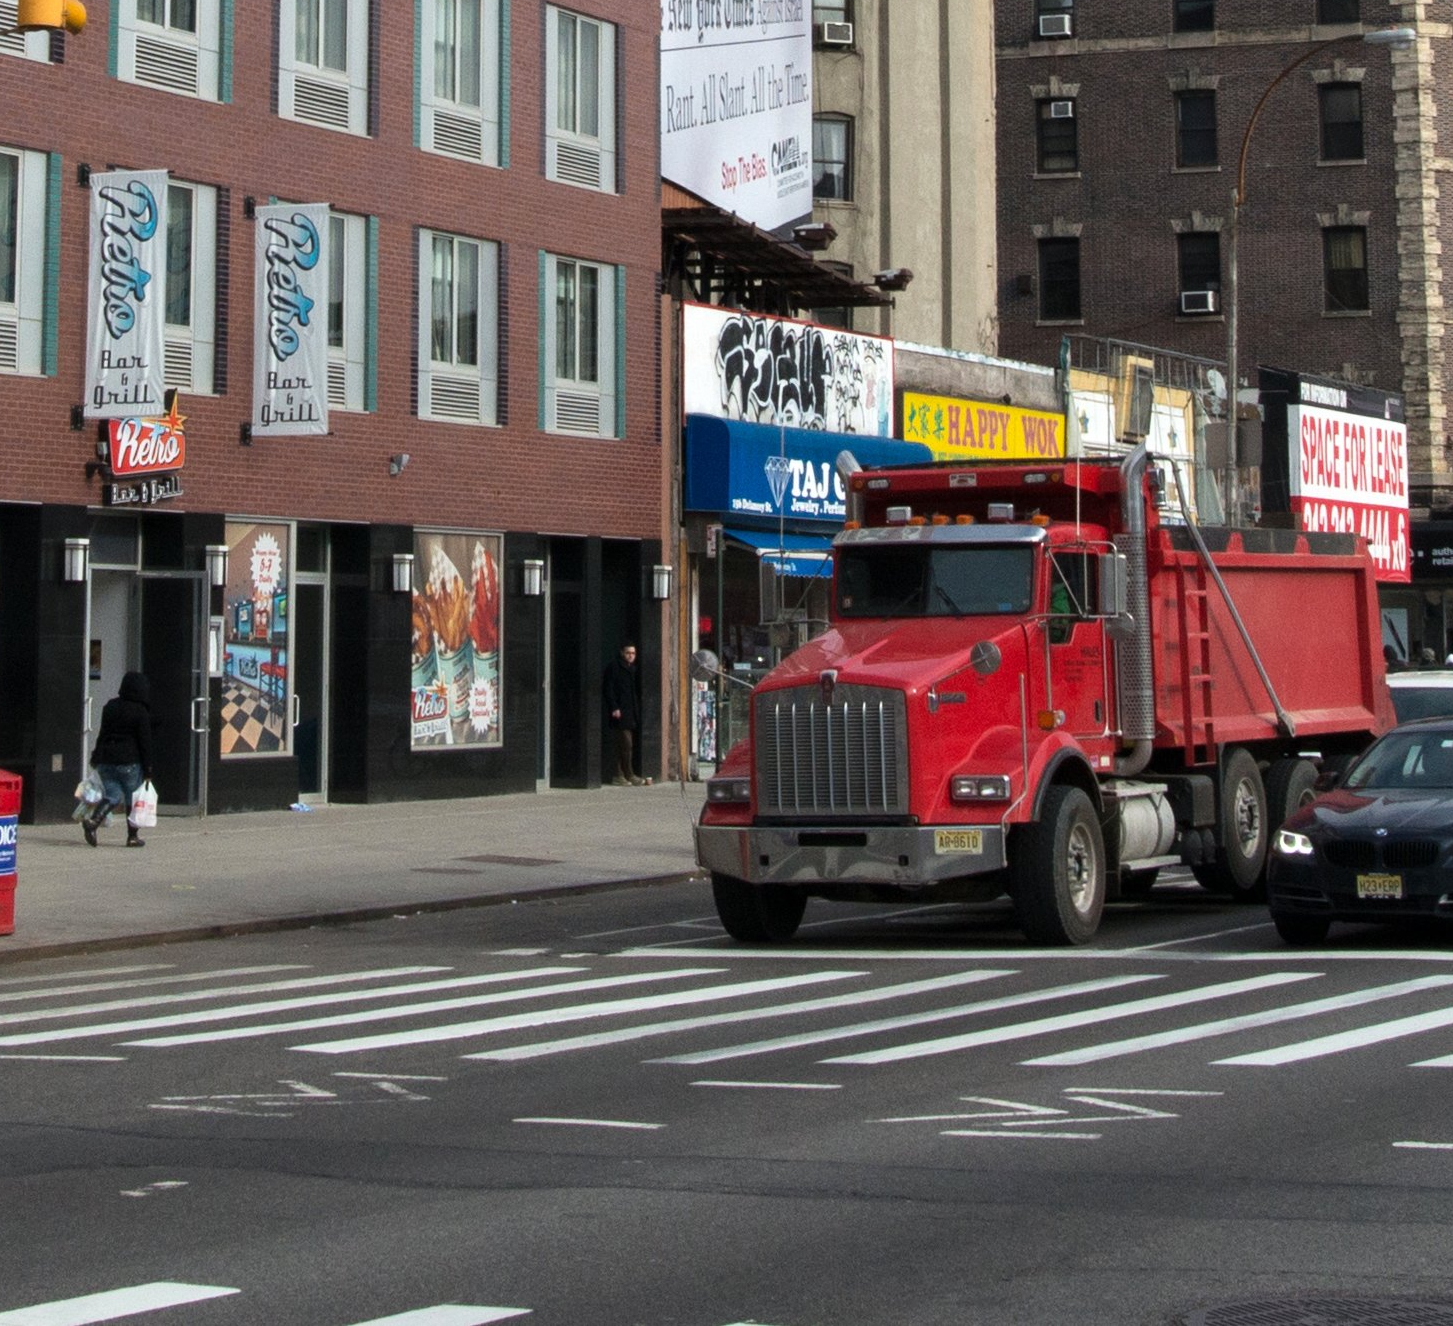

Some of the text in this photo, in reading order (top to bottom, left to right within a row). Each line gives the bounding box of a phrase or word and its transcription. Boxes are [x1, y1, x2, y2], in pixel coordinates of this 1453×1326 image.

[666, 61, 809, 134] Rant. All Slant. All the Time.
[721, 159, 738, 193] Stop
[738, 155, 751, 185] The
[99, 180, 158, 340] Retro
[264, 212, 320, 362] Retro
[100, 350, 148, 370] Bar
[267, 371, 312, 390] Bar
[117, 418, 180, 469] Retro
[947, 404, 1060, 458] HAPPY WOK
[1302, 414, 1404, 497] SPACE FOR LEASE
[789, 459, 831, 499] TAJ
[790, 498, 819, 516] Jewelry
